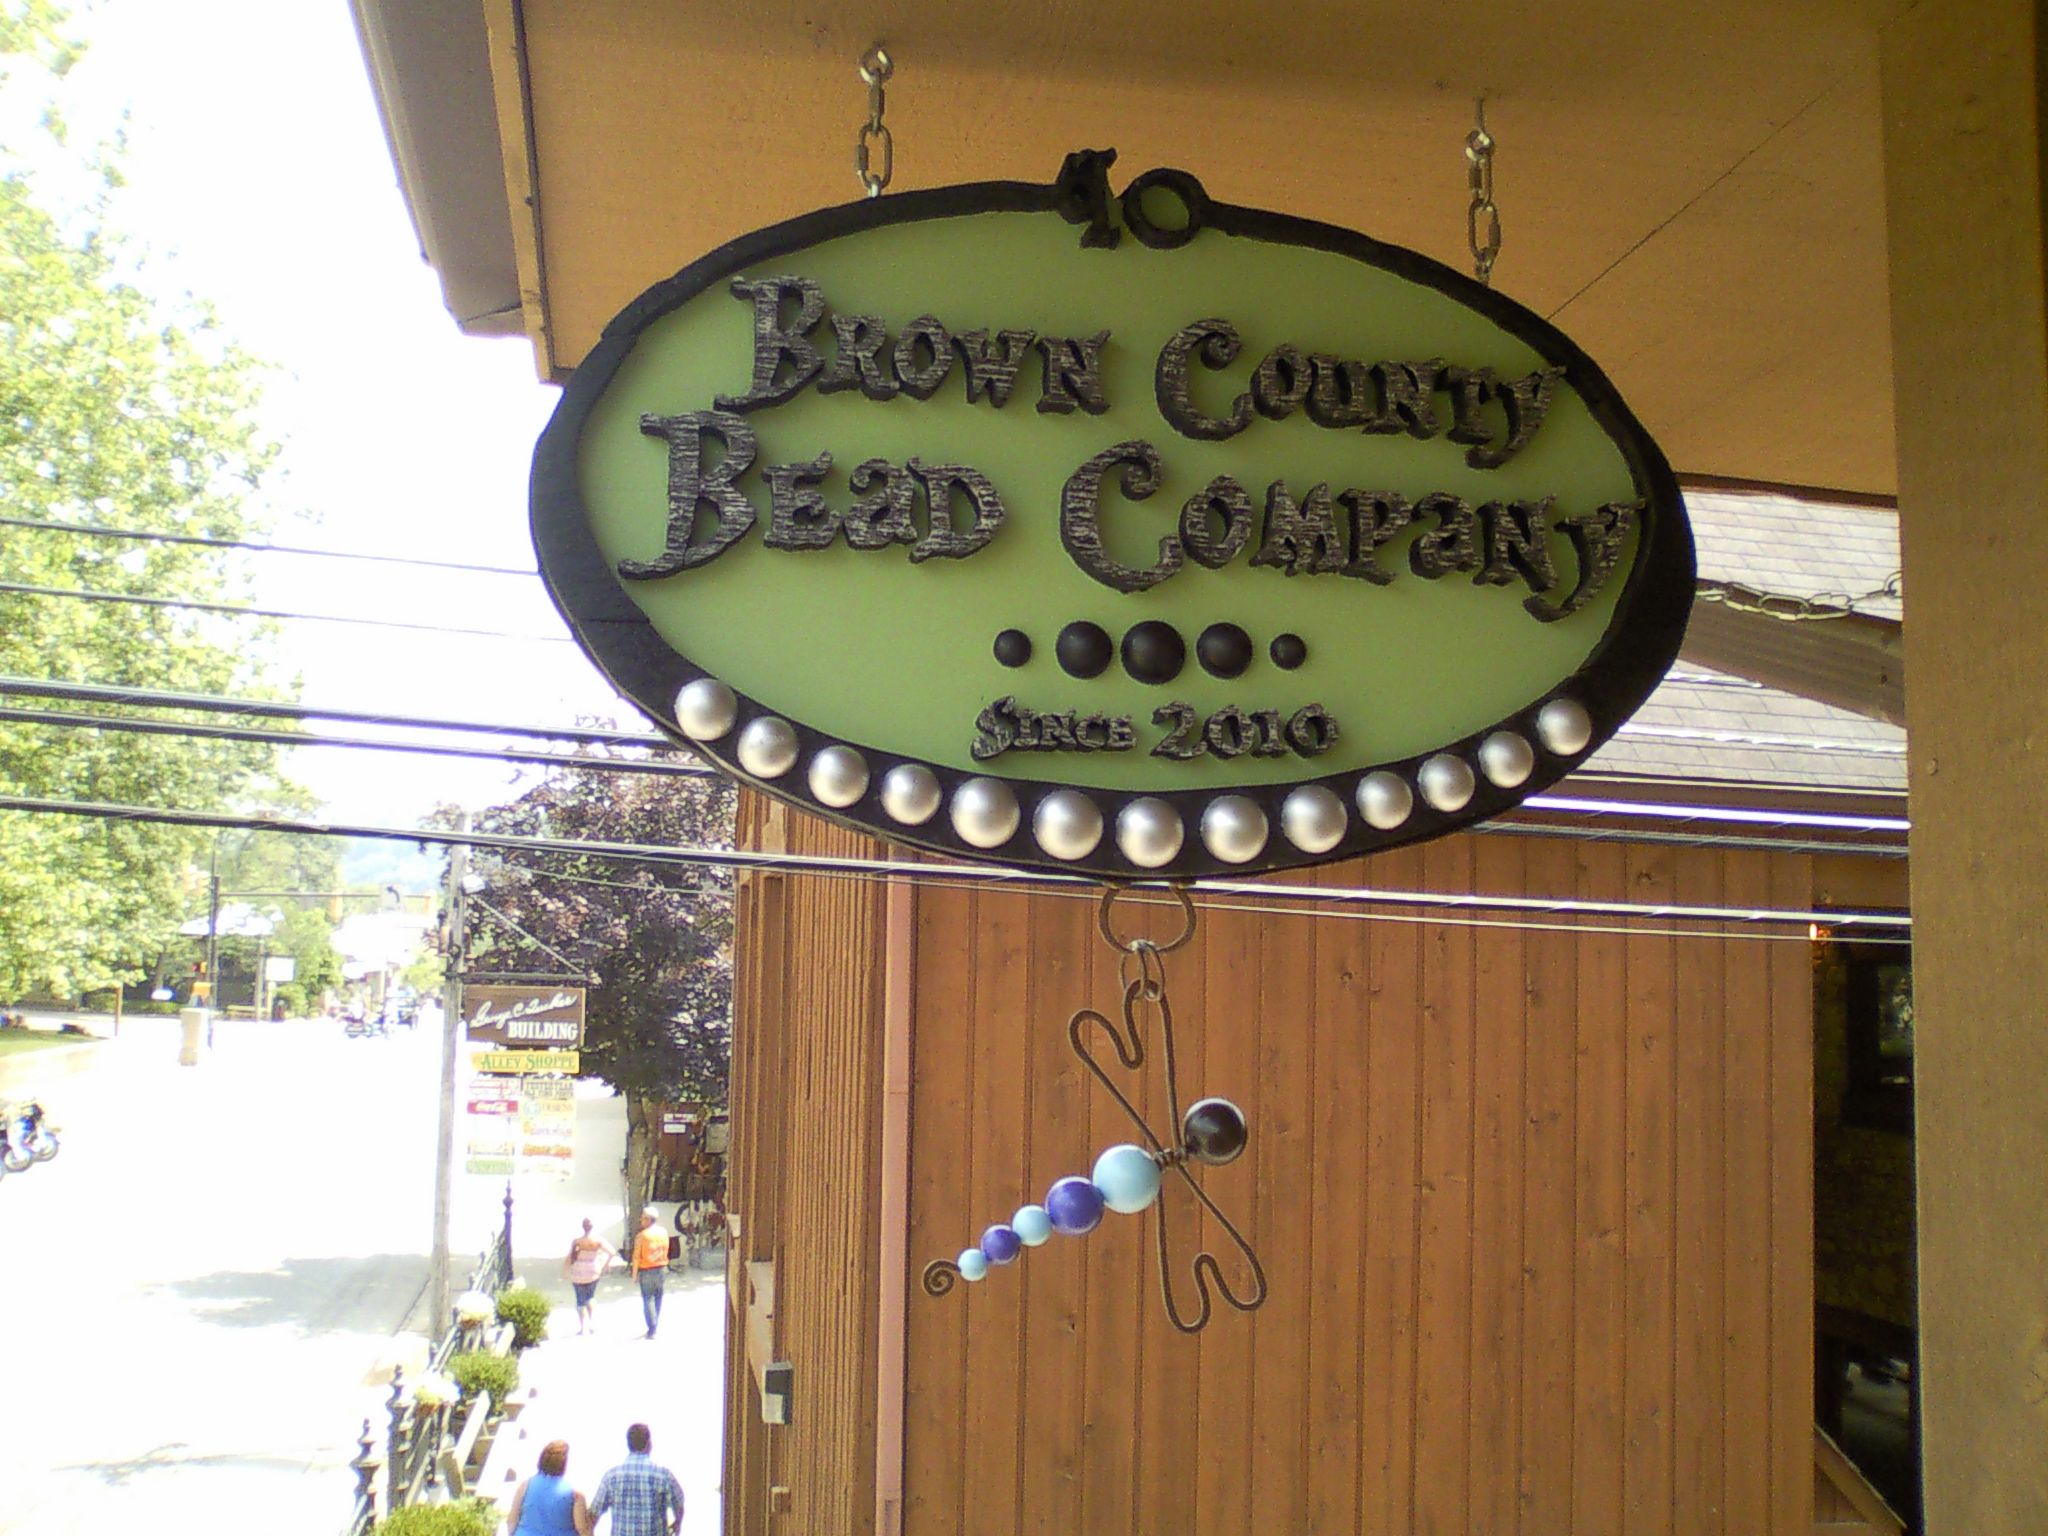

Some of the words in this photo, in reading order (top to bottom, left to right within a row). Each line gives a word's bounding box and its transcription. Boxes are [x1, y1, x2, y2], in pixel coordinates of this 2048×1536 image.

[713, 274, 1111, 415] BROWN
[1154, 318, 1567, 470] COUNTY
[617, 408, 1005, 580] BEAD
[1060, 439, 1645, 623] COMPANY
[970, 695, 1137, 762] SINCE
[1150, 700, 1340, 760] 2010
[481, 1053, 521, 1070] ALLEY
[526, 1053, 577, 1071] SHOPPE
[507, 1020, 579, 1041] BUILDING
